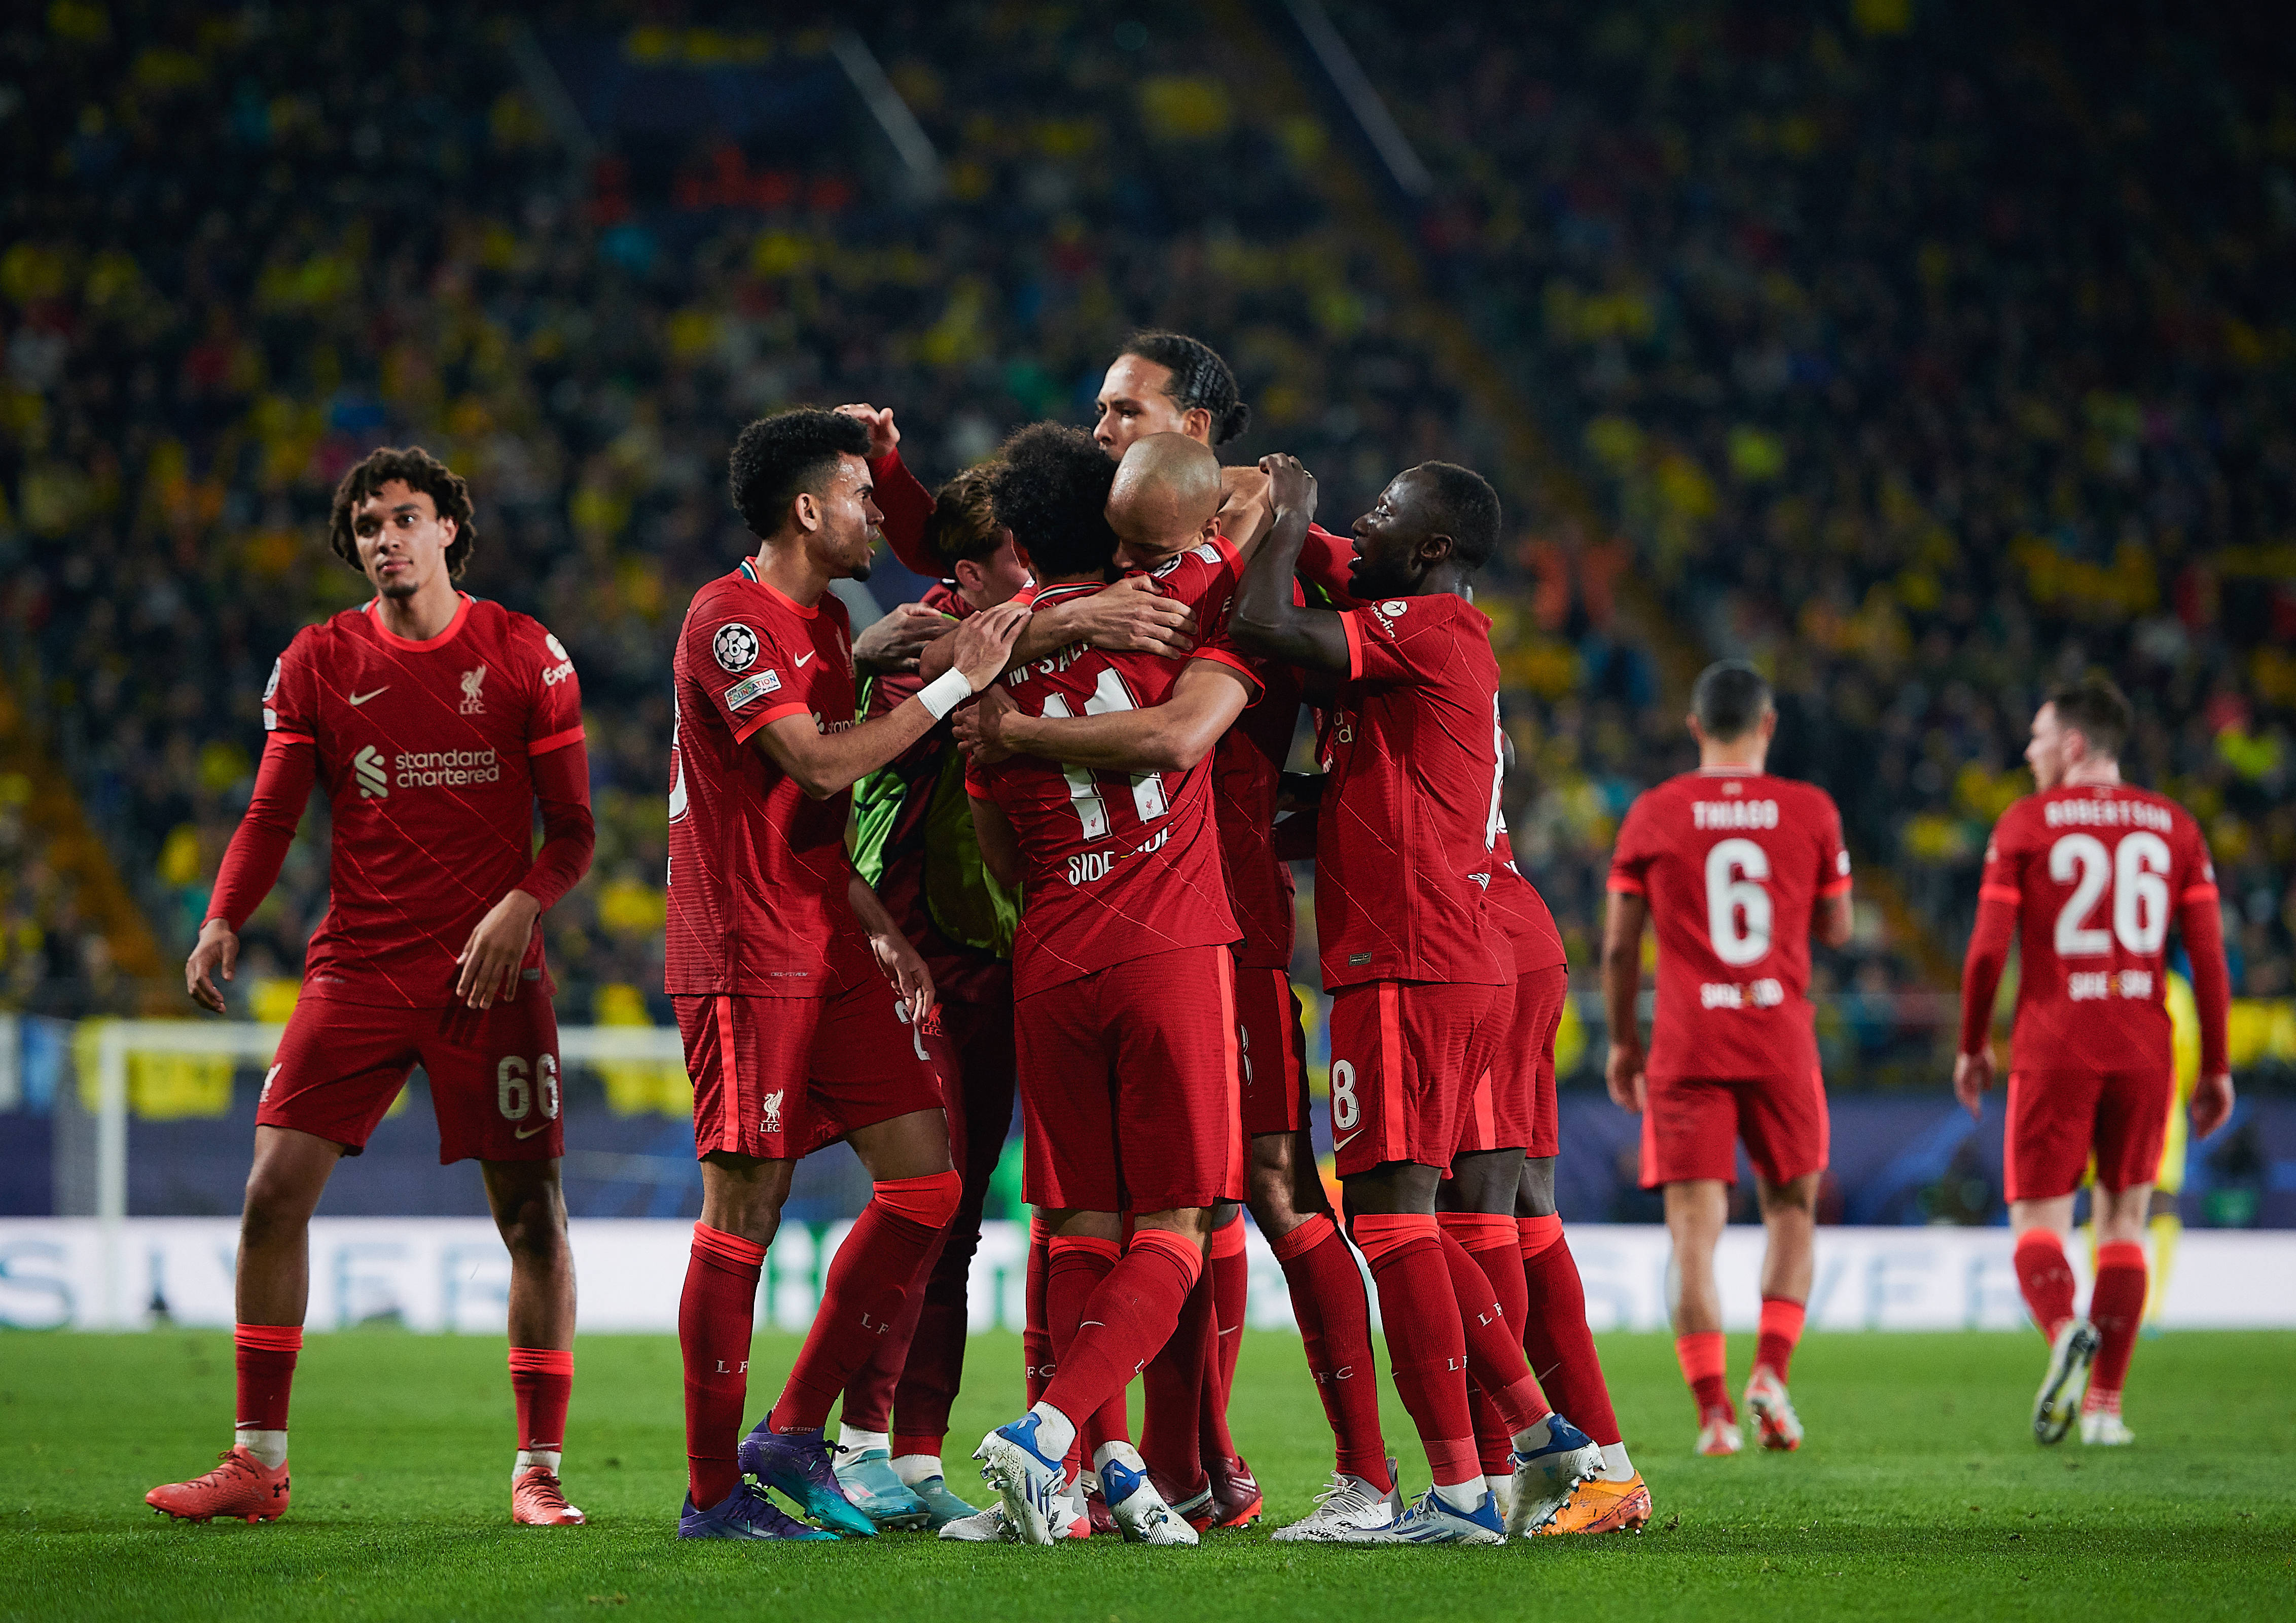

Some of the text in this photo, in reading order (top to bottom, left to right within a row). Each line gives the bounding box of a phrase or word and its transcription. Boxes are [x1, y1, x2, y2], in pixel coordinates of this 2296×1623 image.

[728, 676, 777, 704] FOUNDATION
[396, 749, 495, 770] standard
[396, 764, 499, 788] chartered
[1705, 837, 1773, 966] 6
[2049, 831, 2171, 959] 26
[497, 1052, 559, 1120] 66
[1333, 1059, 1360, 1131] 8
[860, 1312, 890, 1335] LF
[1026, 1364, 1056, 1379] FC
[1309, 1365, 1354, 1384] FC
